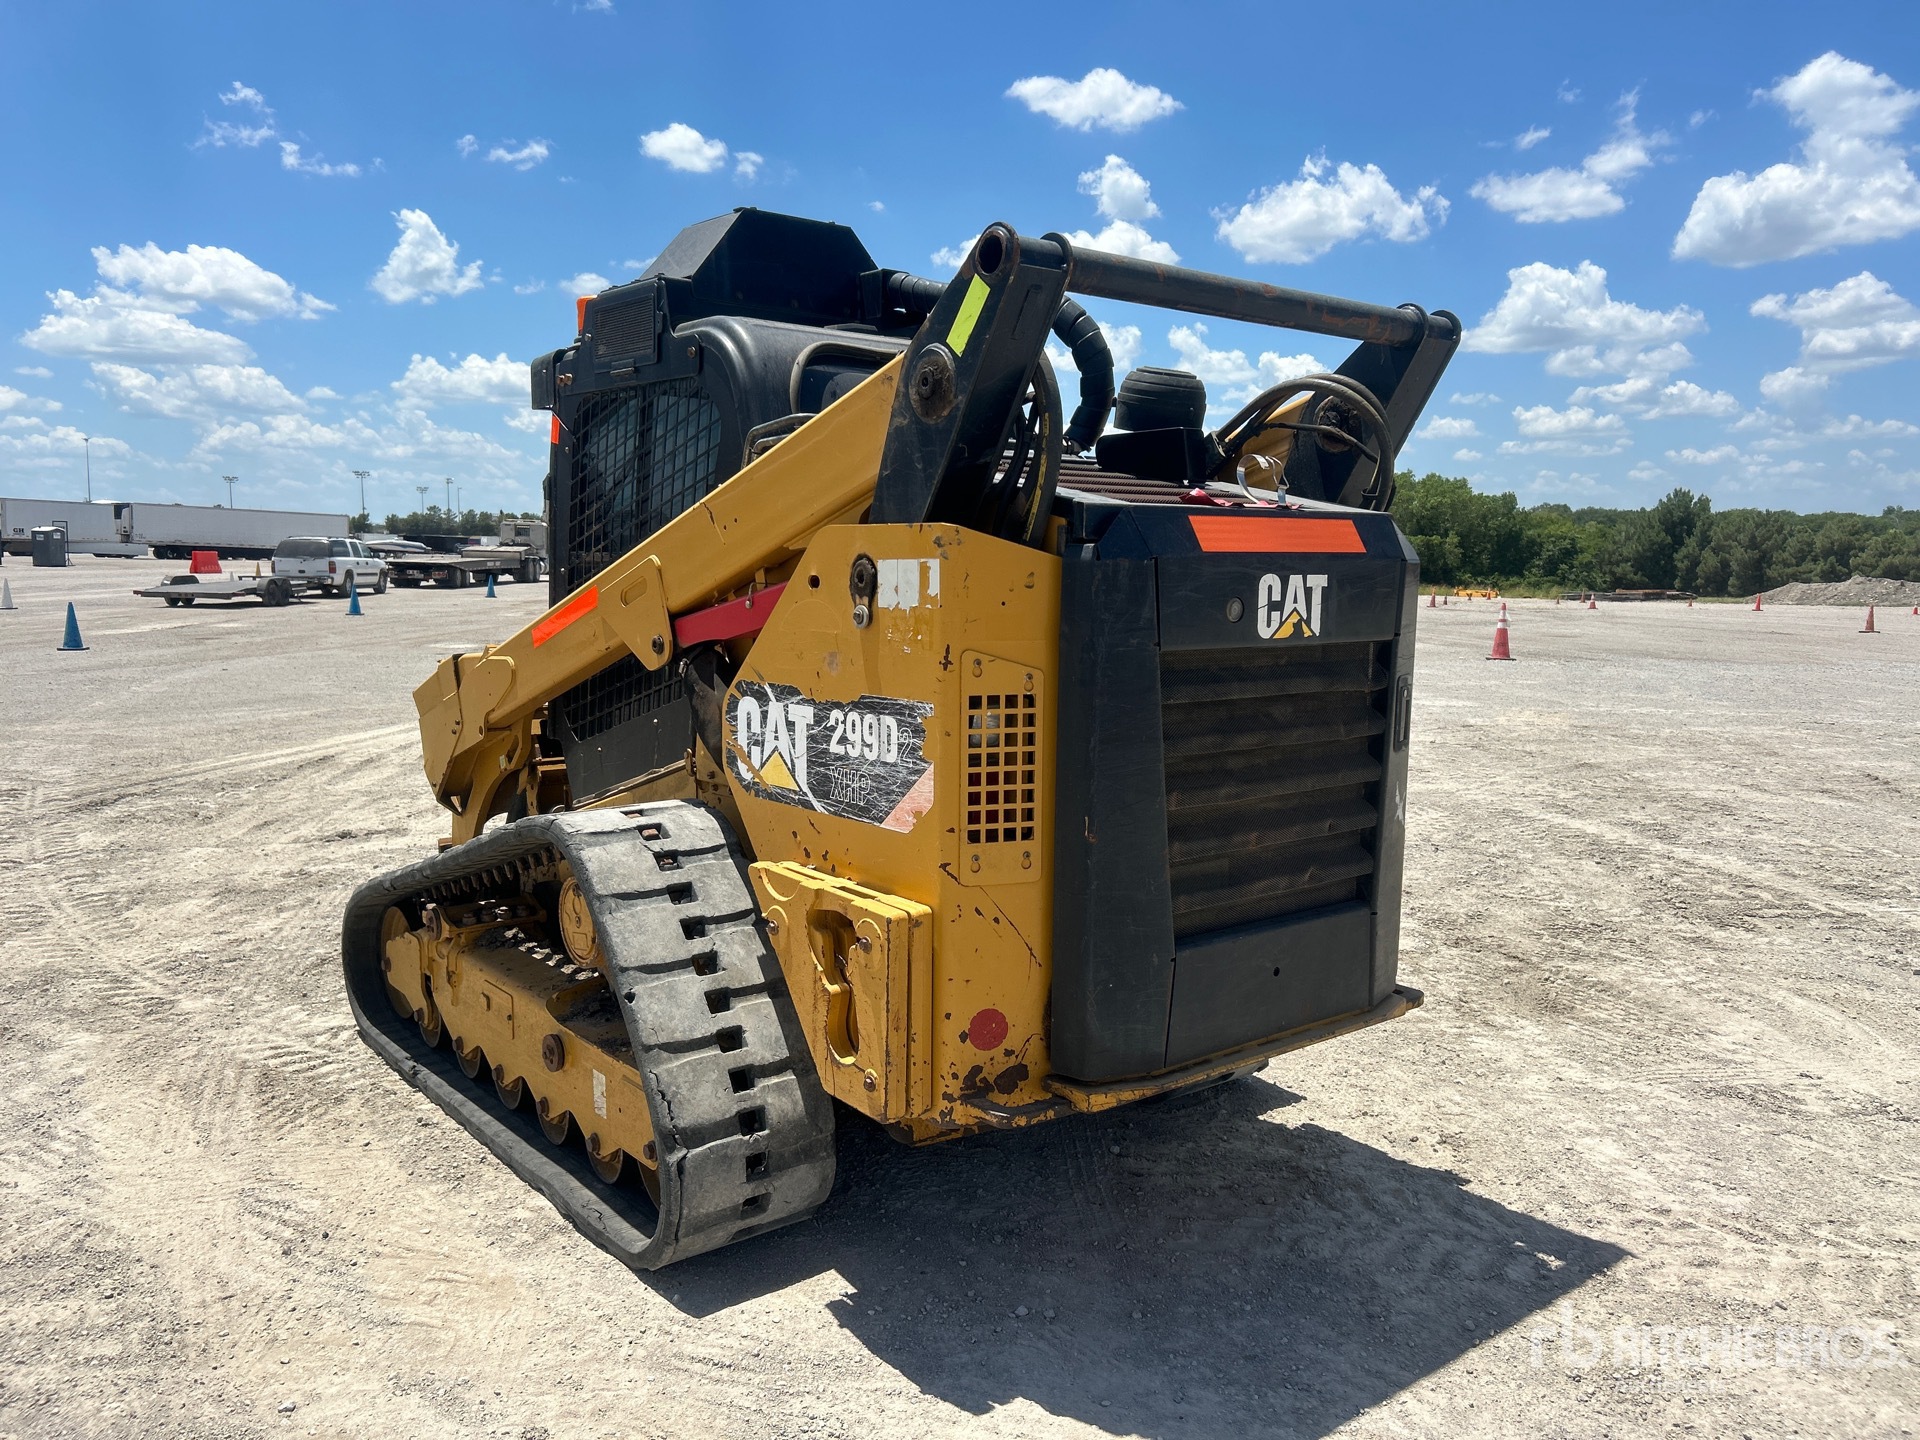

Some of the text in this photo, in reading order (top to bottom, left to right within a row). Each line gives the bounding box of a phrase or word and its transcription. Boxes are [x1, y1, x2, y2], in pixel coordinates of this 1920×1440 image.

[1257, 573, 1328, 639] CAT
[737, 696, 814, 792] CAT
[829, 766, 871, 805] XHP
